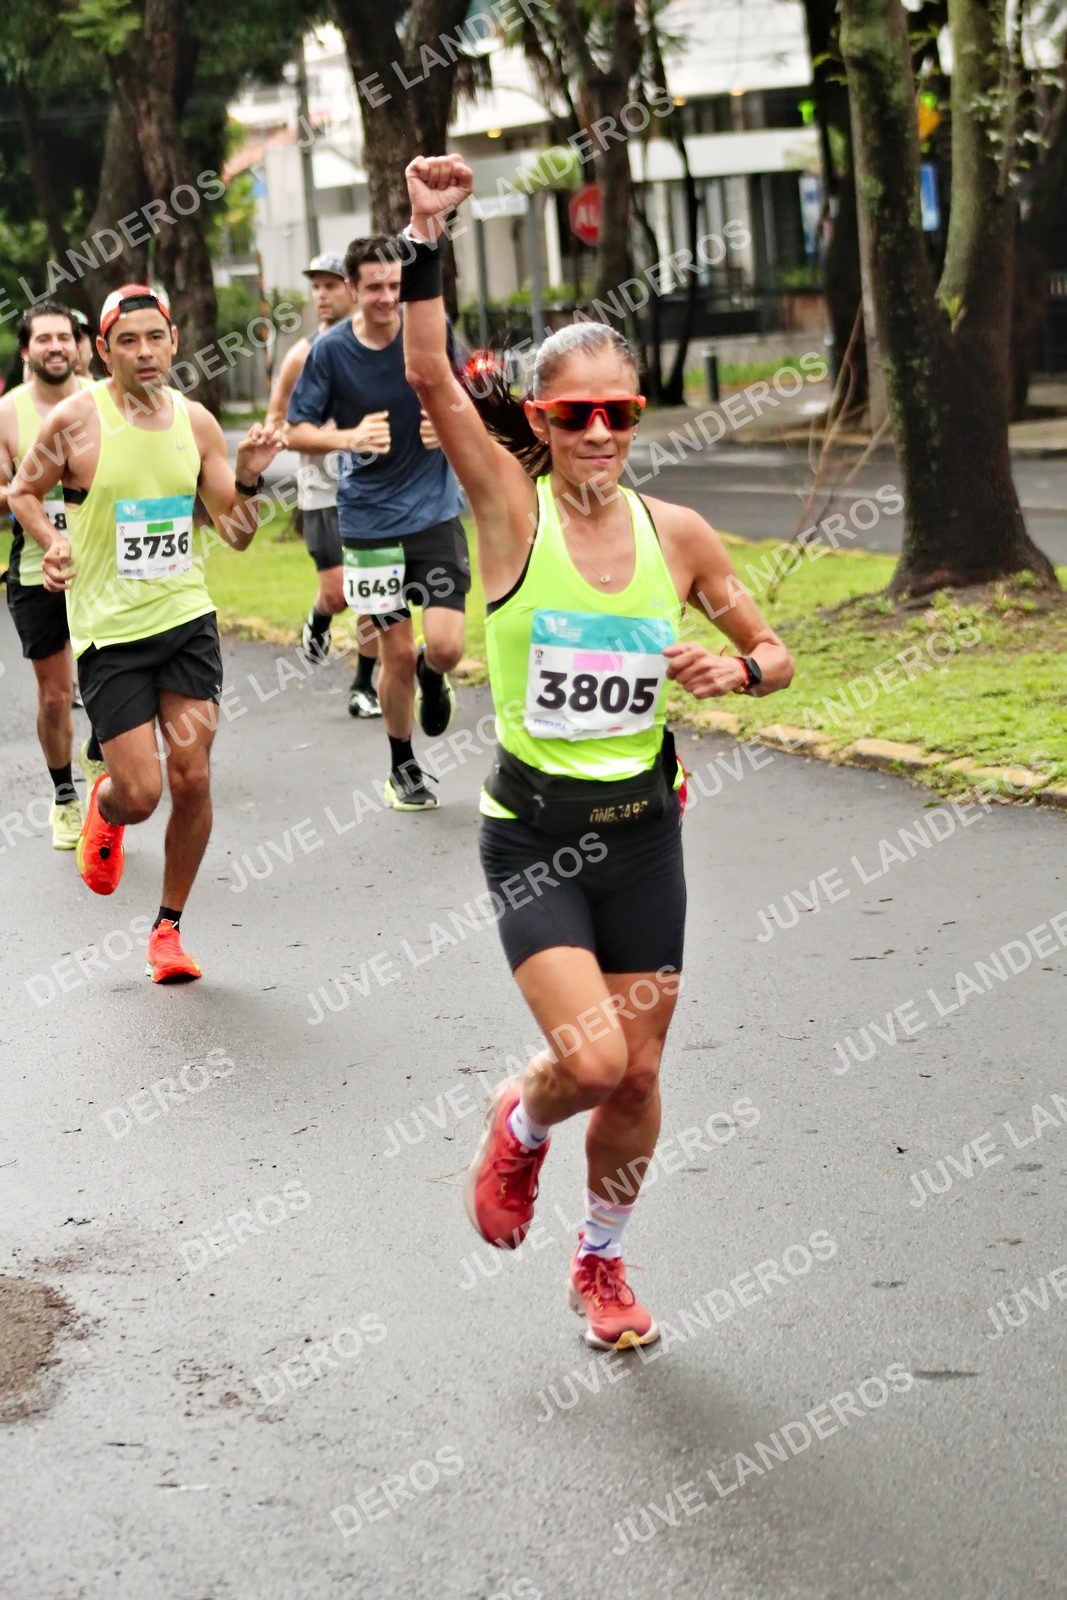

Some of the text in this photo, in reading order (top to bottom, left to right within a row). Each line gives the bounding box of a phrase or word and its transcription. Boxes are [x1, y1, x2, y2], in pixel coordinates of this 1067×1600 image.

[124, 532, 189, 560] 3736
[349, 578, 401, 597] 1649
[536, 670, 658, 714] 3805
